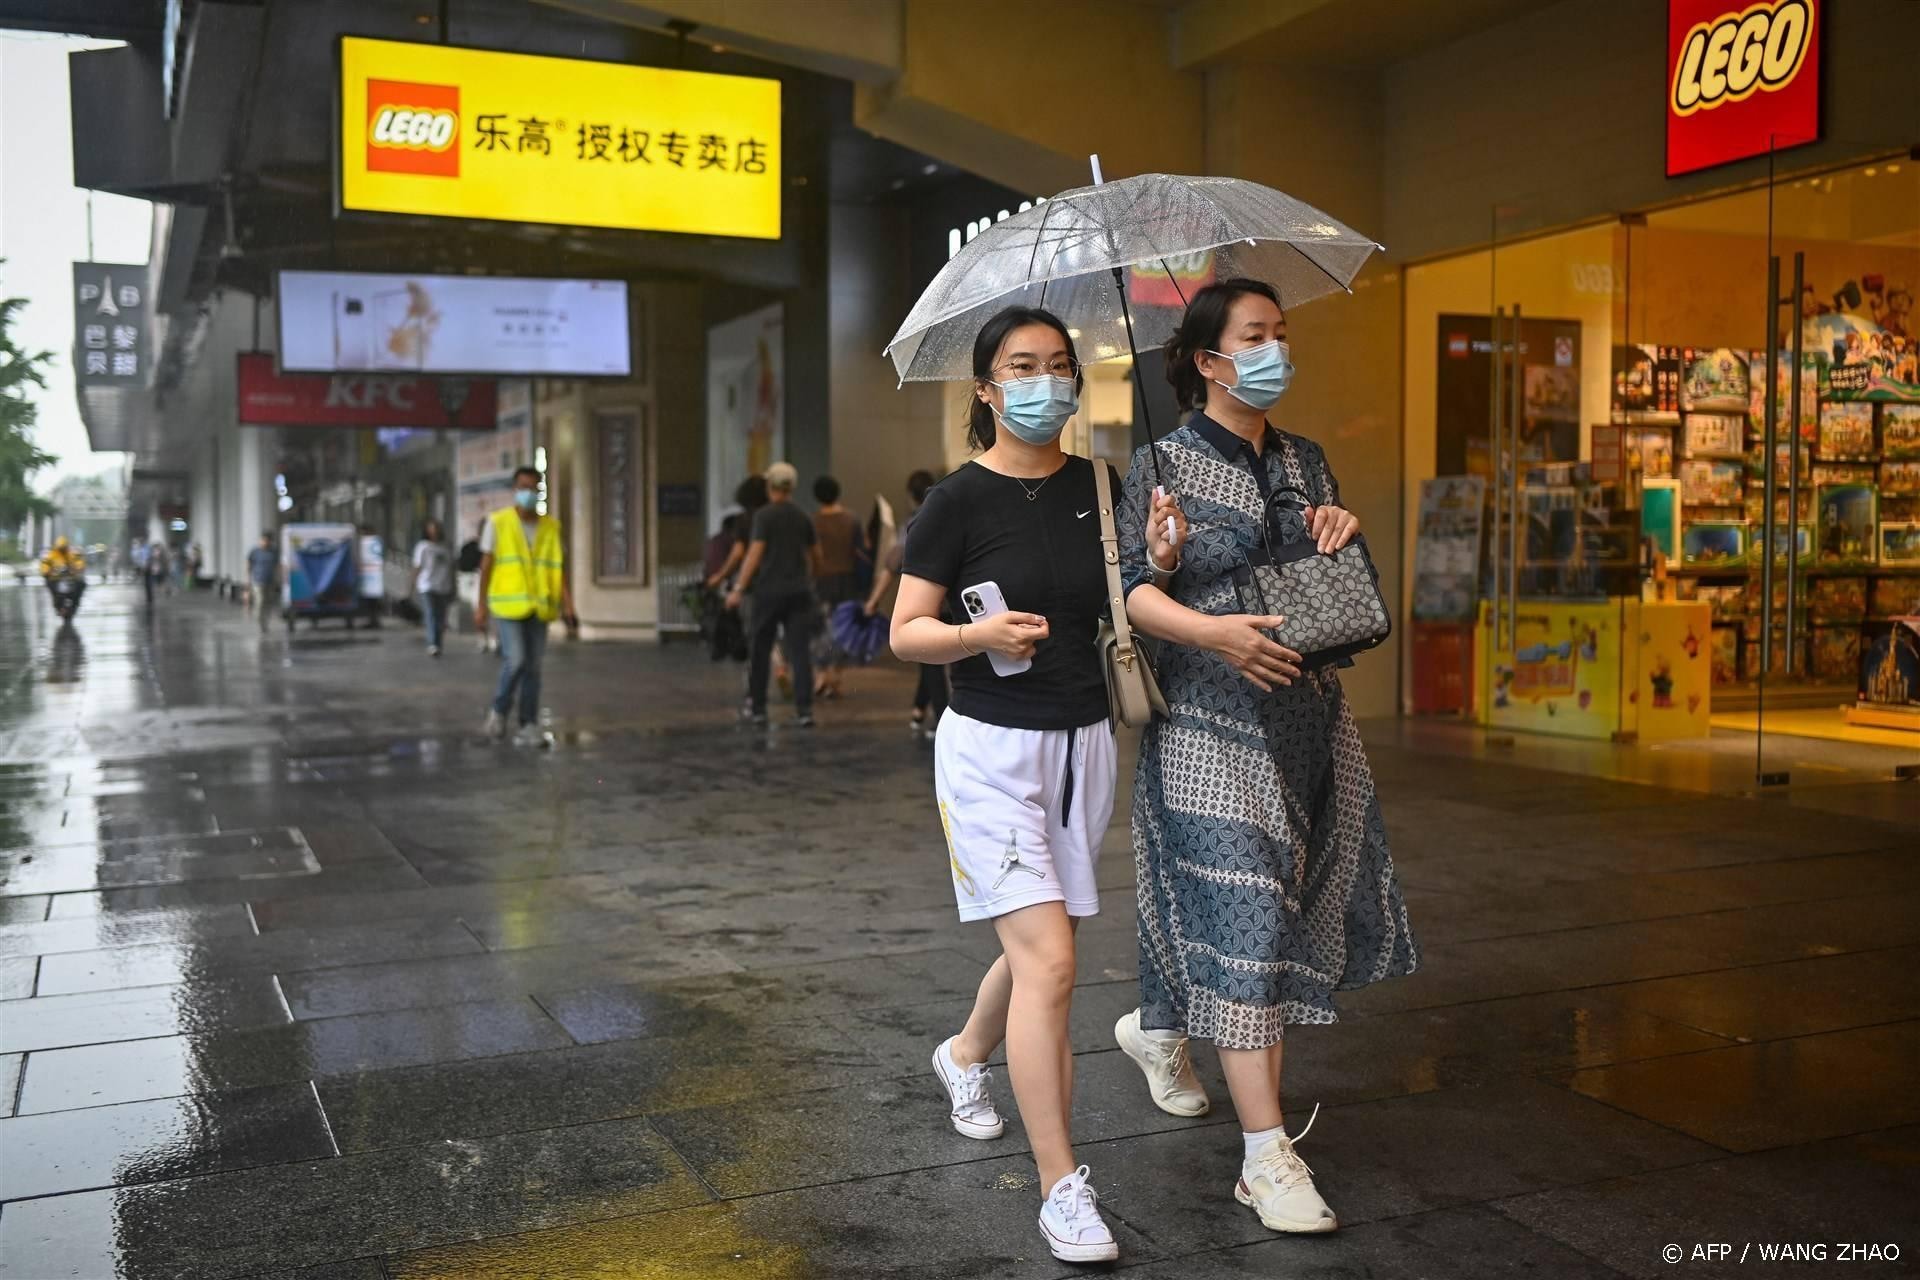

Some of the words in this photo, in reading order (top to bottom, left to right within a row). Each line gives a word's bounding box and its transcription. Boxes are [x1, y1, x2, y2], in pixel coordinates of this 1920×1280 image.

[1677, 3, 1806, 107] LEGO
[372, 107, 454, 148] LEGO
[576, 121, 768, 176] 授权专卖店
[326, 374, 418, 411] KFC
